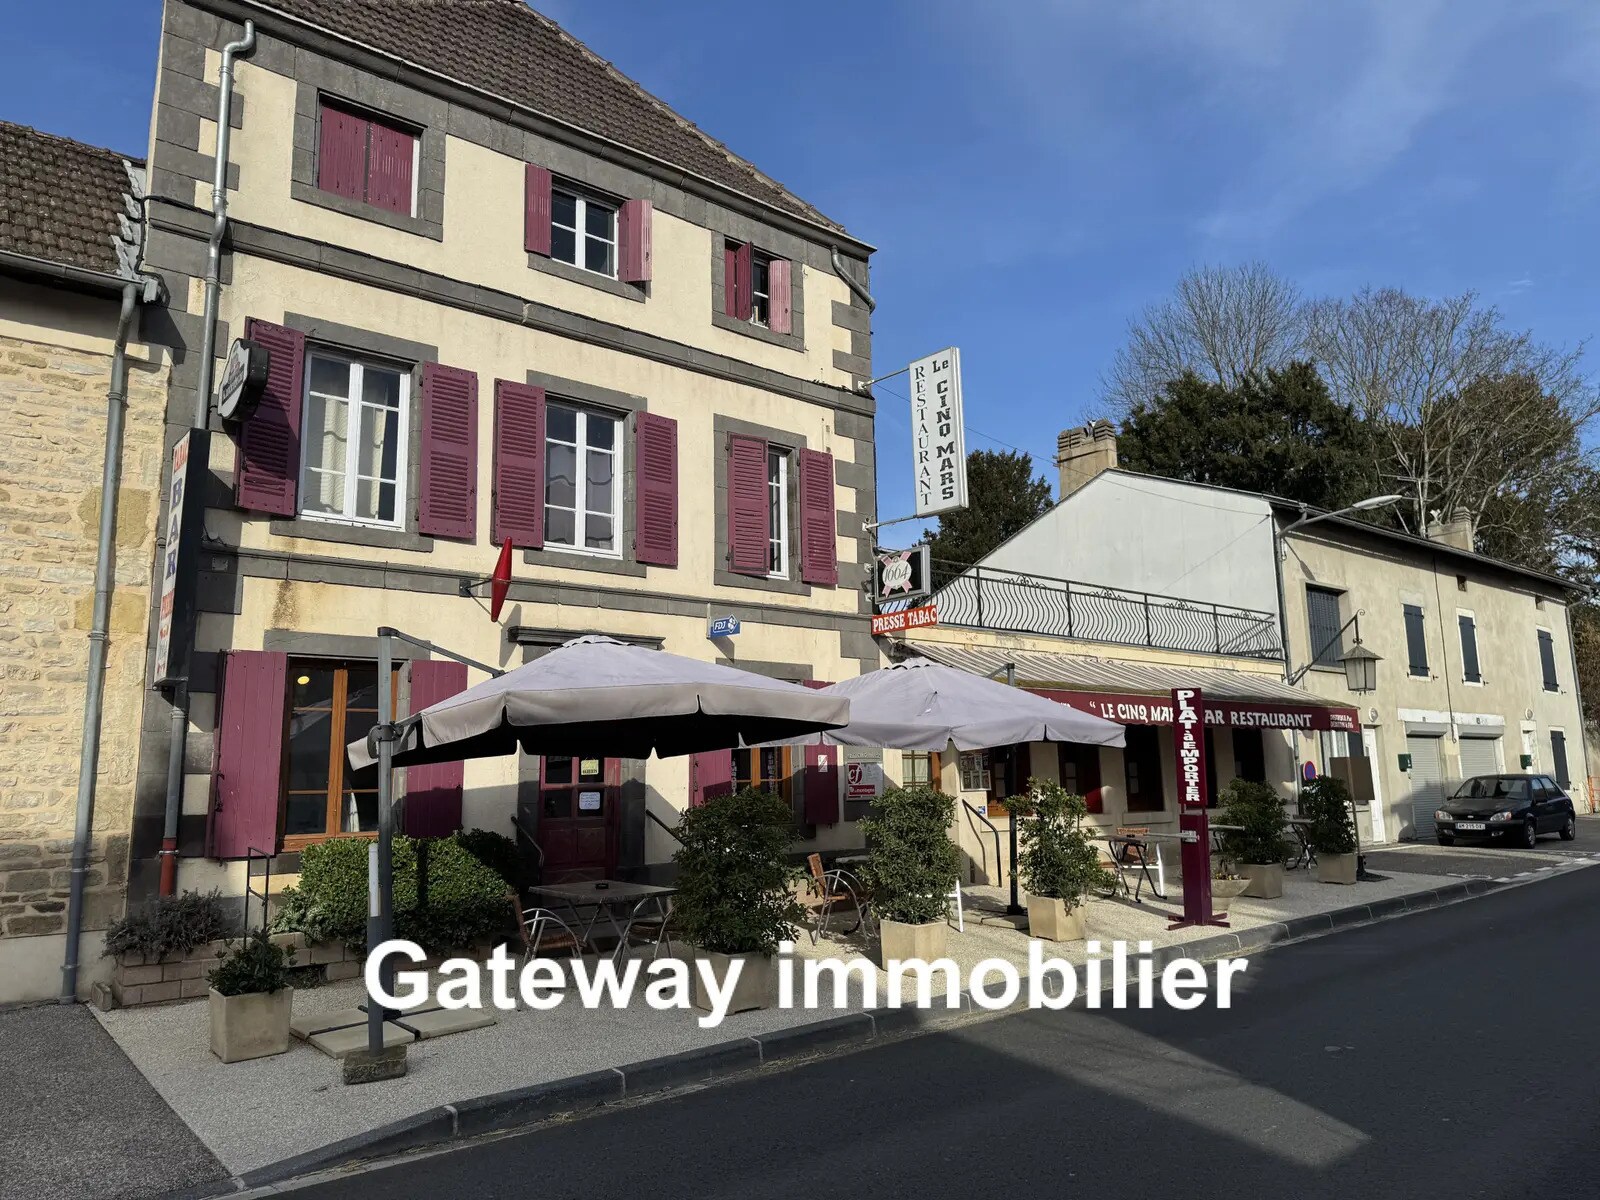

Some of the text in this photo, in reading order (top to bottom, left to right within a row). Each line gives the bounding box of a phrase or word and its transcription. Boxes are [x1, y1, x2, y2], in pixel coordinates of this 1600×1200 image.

[933, 359, 949, 374] Le
[915, 365, 932, 506] RESTAURANT
[936, 379, 955, 500] CINQ MARS
[166, 477, 183, 580] BAR
[885, 564, 909, 582] 1664
[714, 620, 727, 631] FDJ
[873, 607, 937, 632] PRESSE TABAC
[1101, 703, 1116, 719] LE
[1117, 704, 1149, 723] CINQ
[1204, 709, 1225, 724] AR
[1230, 711, 1312, 727] RESTAURANT
[1177, 690, 1198, 729] PLAT
[1180, 741, 1200, 802] EMPORTER
